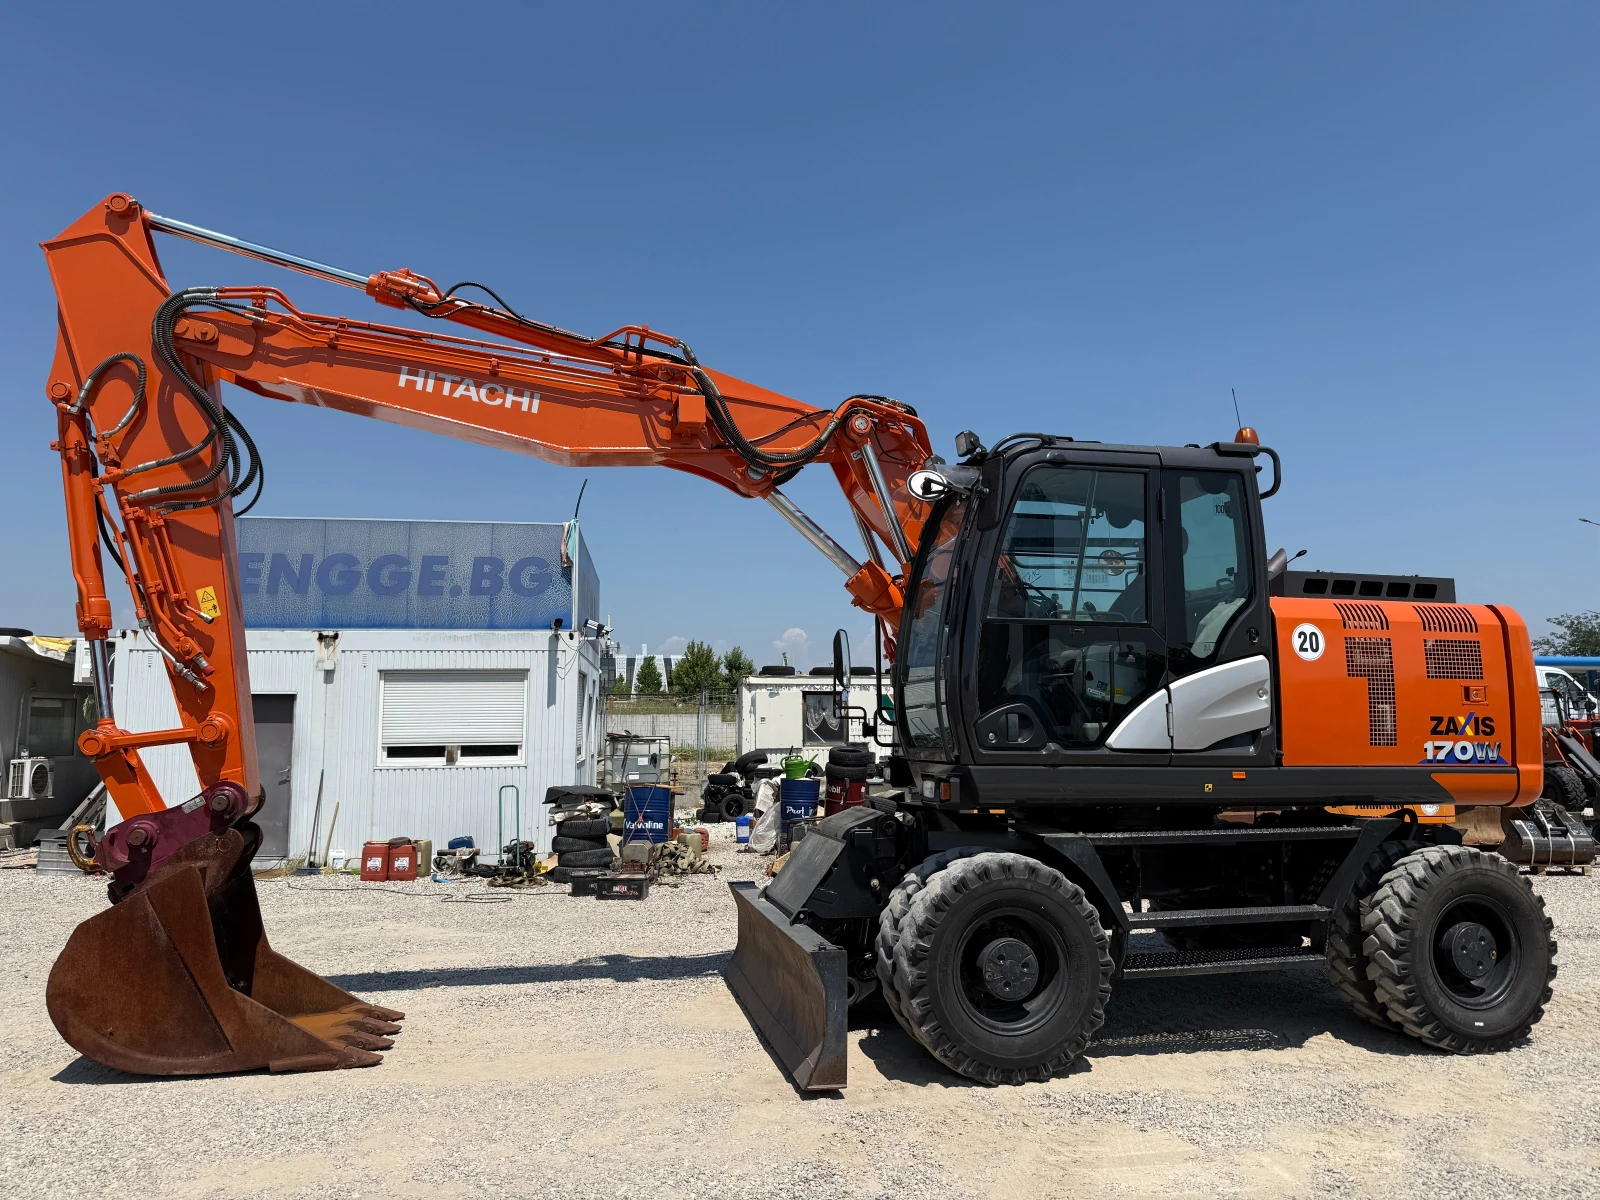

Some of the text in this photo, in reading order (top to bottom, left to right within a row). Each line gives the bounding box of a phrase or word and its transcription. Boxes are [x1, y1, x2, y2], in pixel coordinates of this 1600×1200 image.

[398, 365, 541, 414] HITACHI
[237, 551, 552, 598] ENGGE.BG
[1297, 630, 1320, 653] 20
[1429, 711, 1496, 737] ZAXIS
[1423, 740, 1501, 763] 170W
[625, 820, 665, 830] Valvoline
